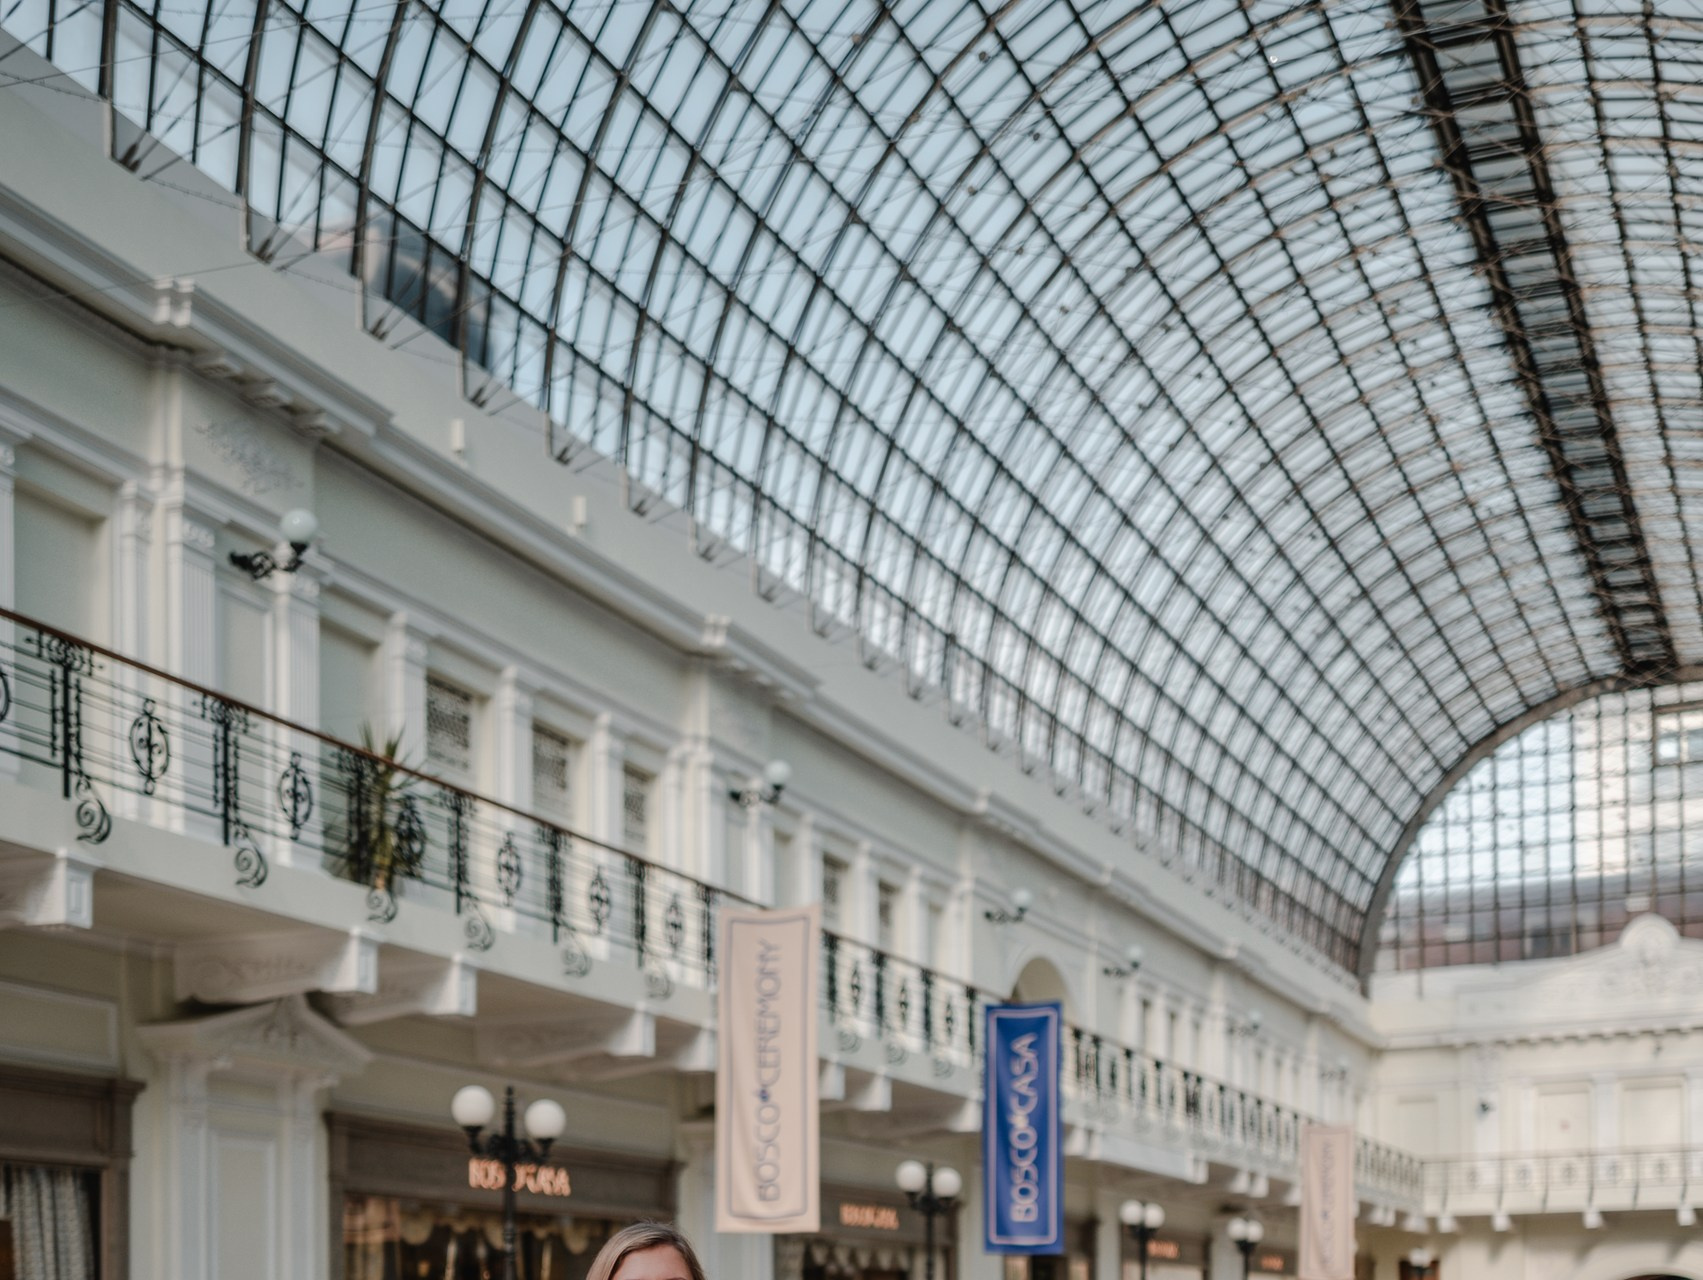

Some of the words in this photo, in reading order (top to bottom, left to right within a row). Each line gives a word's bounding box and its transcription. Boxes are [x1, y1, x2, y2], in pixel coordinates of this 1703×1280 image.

[1009, 1032, 1039, 1116] CASA
[757, 1103, 781, 1202] BOSCO
[1009, 1125, 1039, 1222] BOSCO
